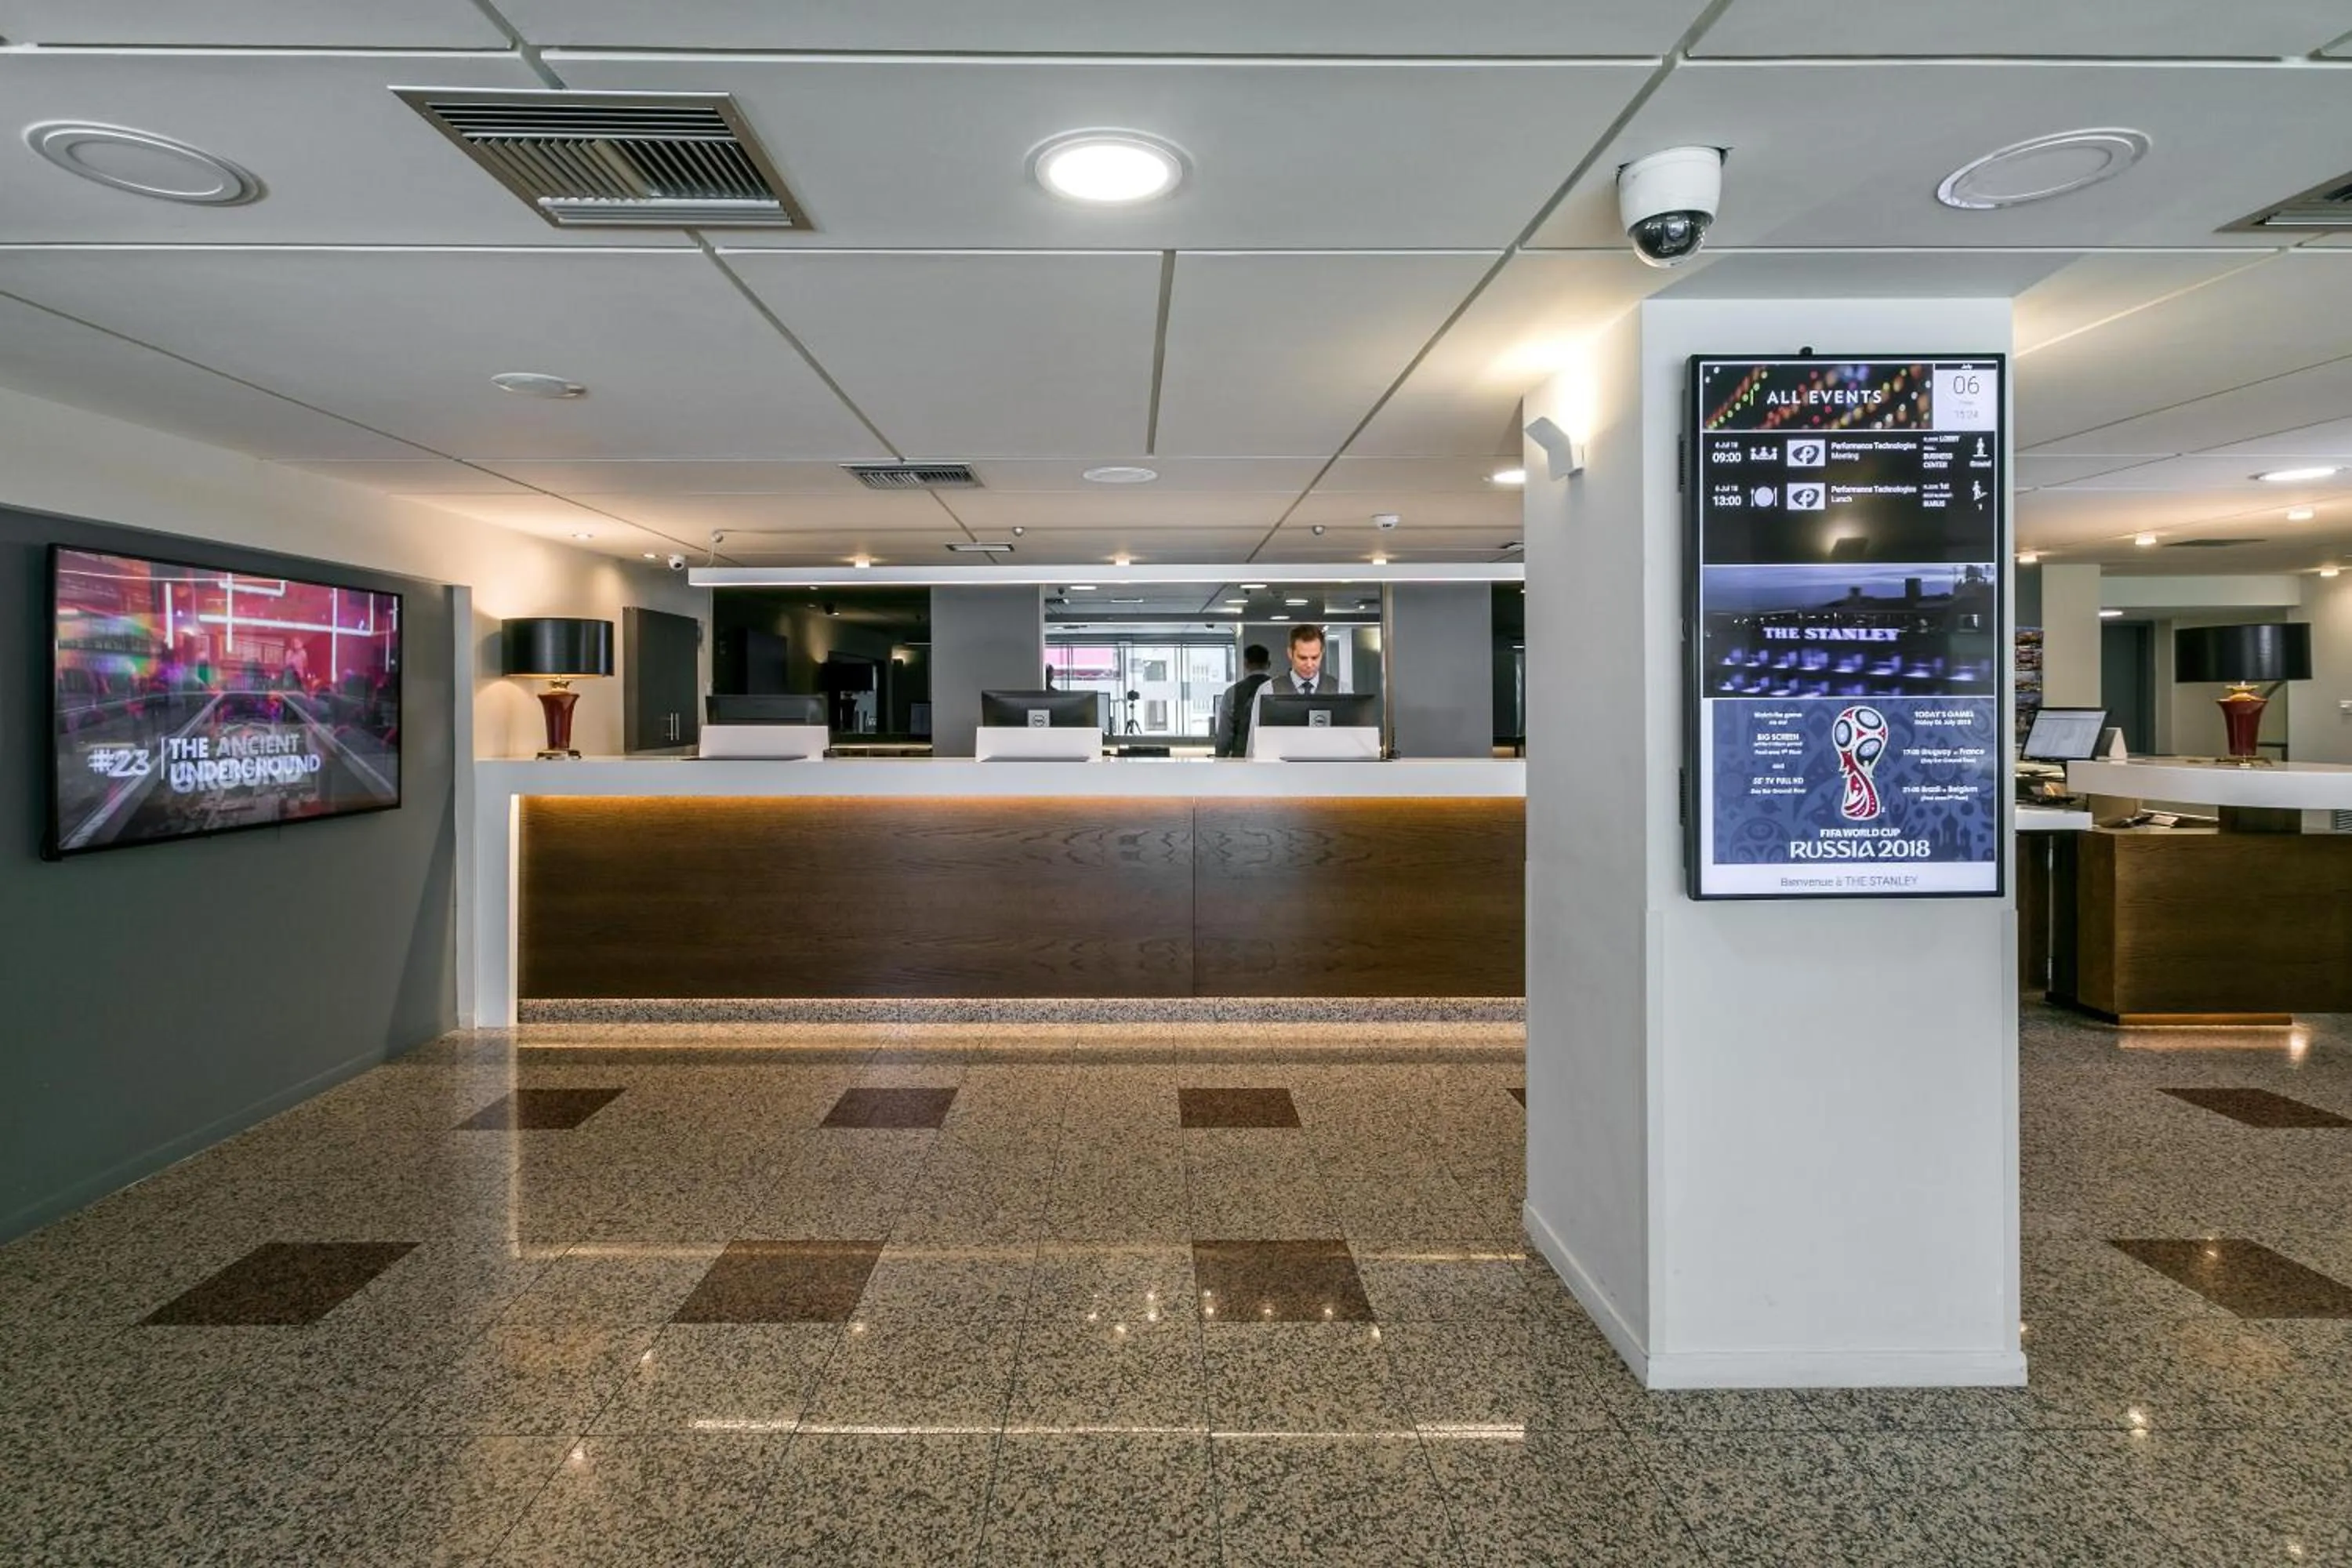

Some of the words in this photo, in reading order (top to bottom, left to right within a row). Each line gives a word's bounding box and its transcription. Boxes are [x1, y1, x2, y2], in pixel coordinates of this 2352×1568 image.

[1953, 376, 1980, 394] 06
[1766, 390, 1802, 405] ALL
[1809, 390, 1882, 405] EVENTS
[1711, 452, 1741, 463] 09:00
[1712, 495, 1741, 506] 13:00
[1764, 627, 1801, 639] THE
[1804, 628, 1900, 641] STANLEY
[88, 749, 151, 777] #23
[169, 737, 209, 760] THE
[216, 733, 300, 757] ANCIENT
[1820, 829, 1842, 837] FIFA
[1842, 828, 1879, 837] WORLD
[1880, 827, 1902, 837] CUP
[1790, 840, 1876, 858] RUSSIA
[1878, 840, 1931, 858] 2018
[1780, 877, 1834, 887] Bienvenue
[1846, 876, 1868, 887] THE
[1870, 875, 1919, 887] STANLEY
